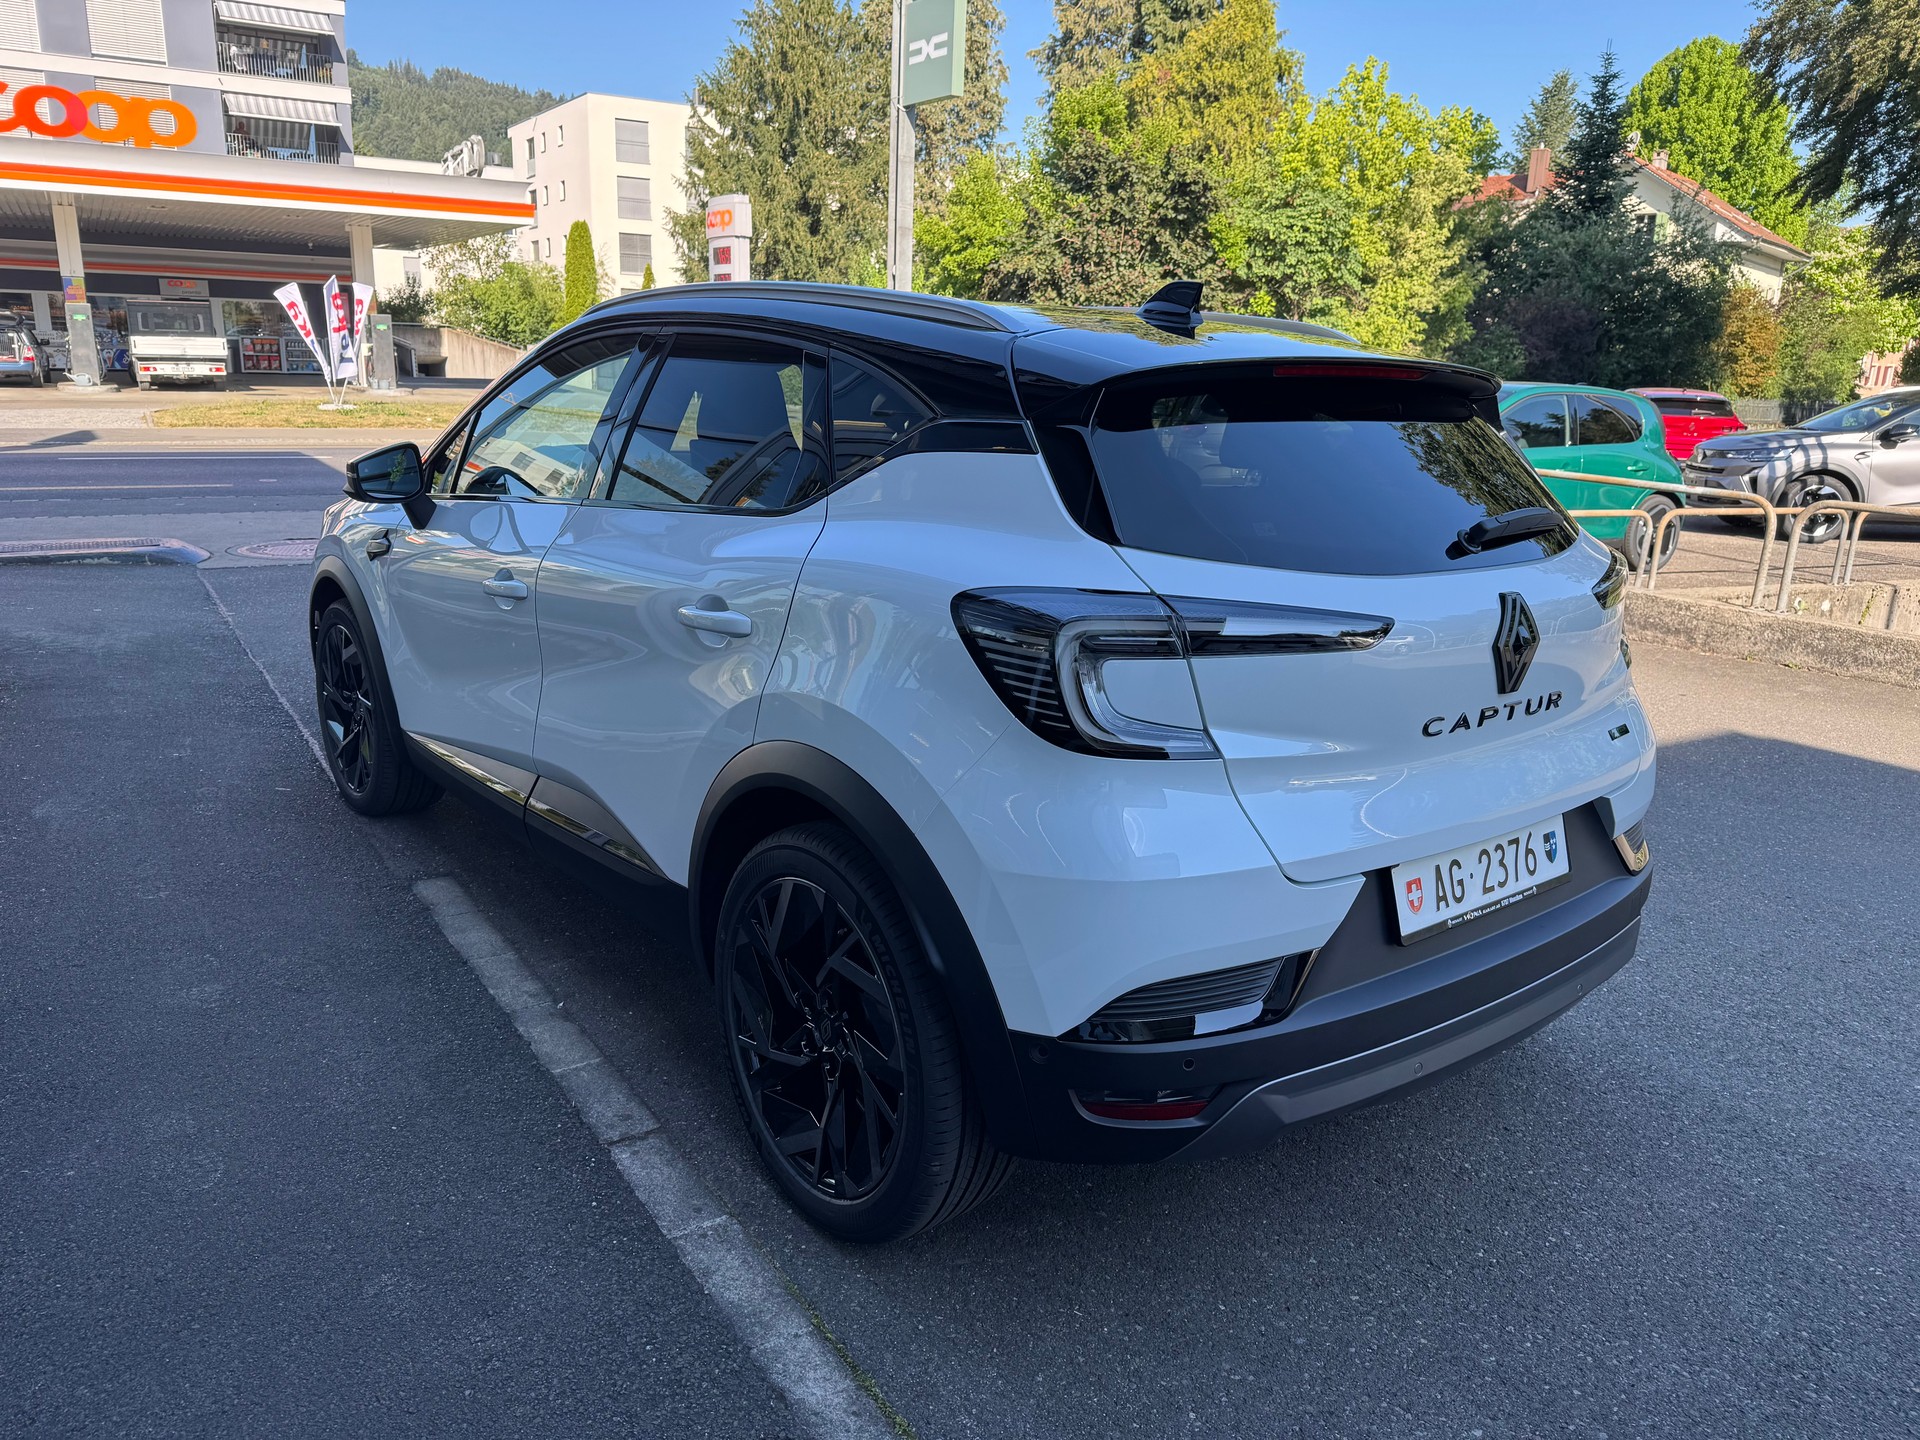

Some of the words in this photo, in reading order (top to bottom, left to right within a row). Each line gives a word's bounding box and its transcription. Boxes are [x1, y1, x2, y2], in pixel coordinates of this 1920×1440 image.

[0, 81, 197, 148] oop
[1422, 690, 1562, 737] CAPTUR
[871, 933, 916, 1056] MICHELIN
